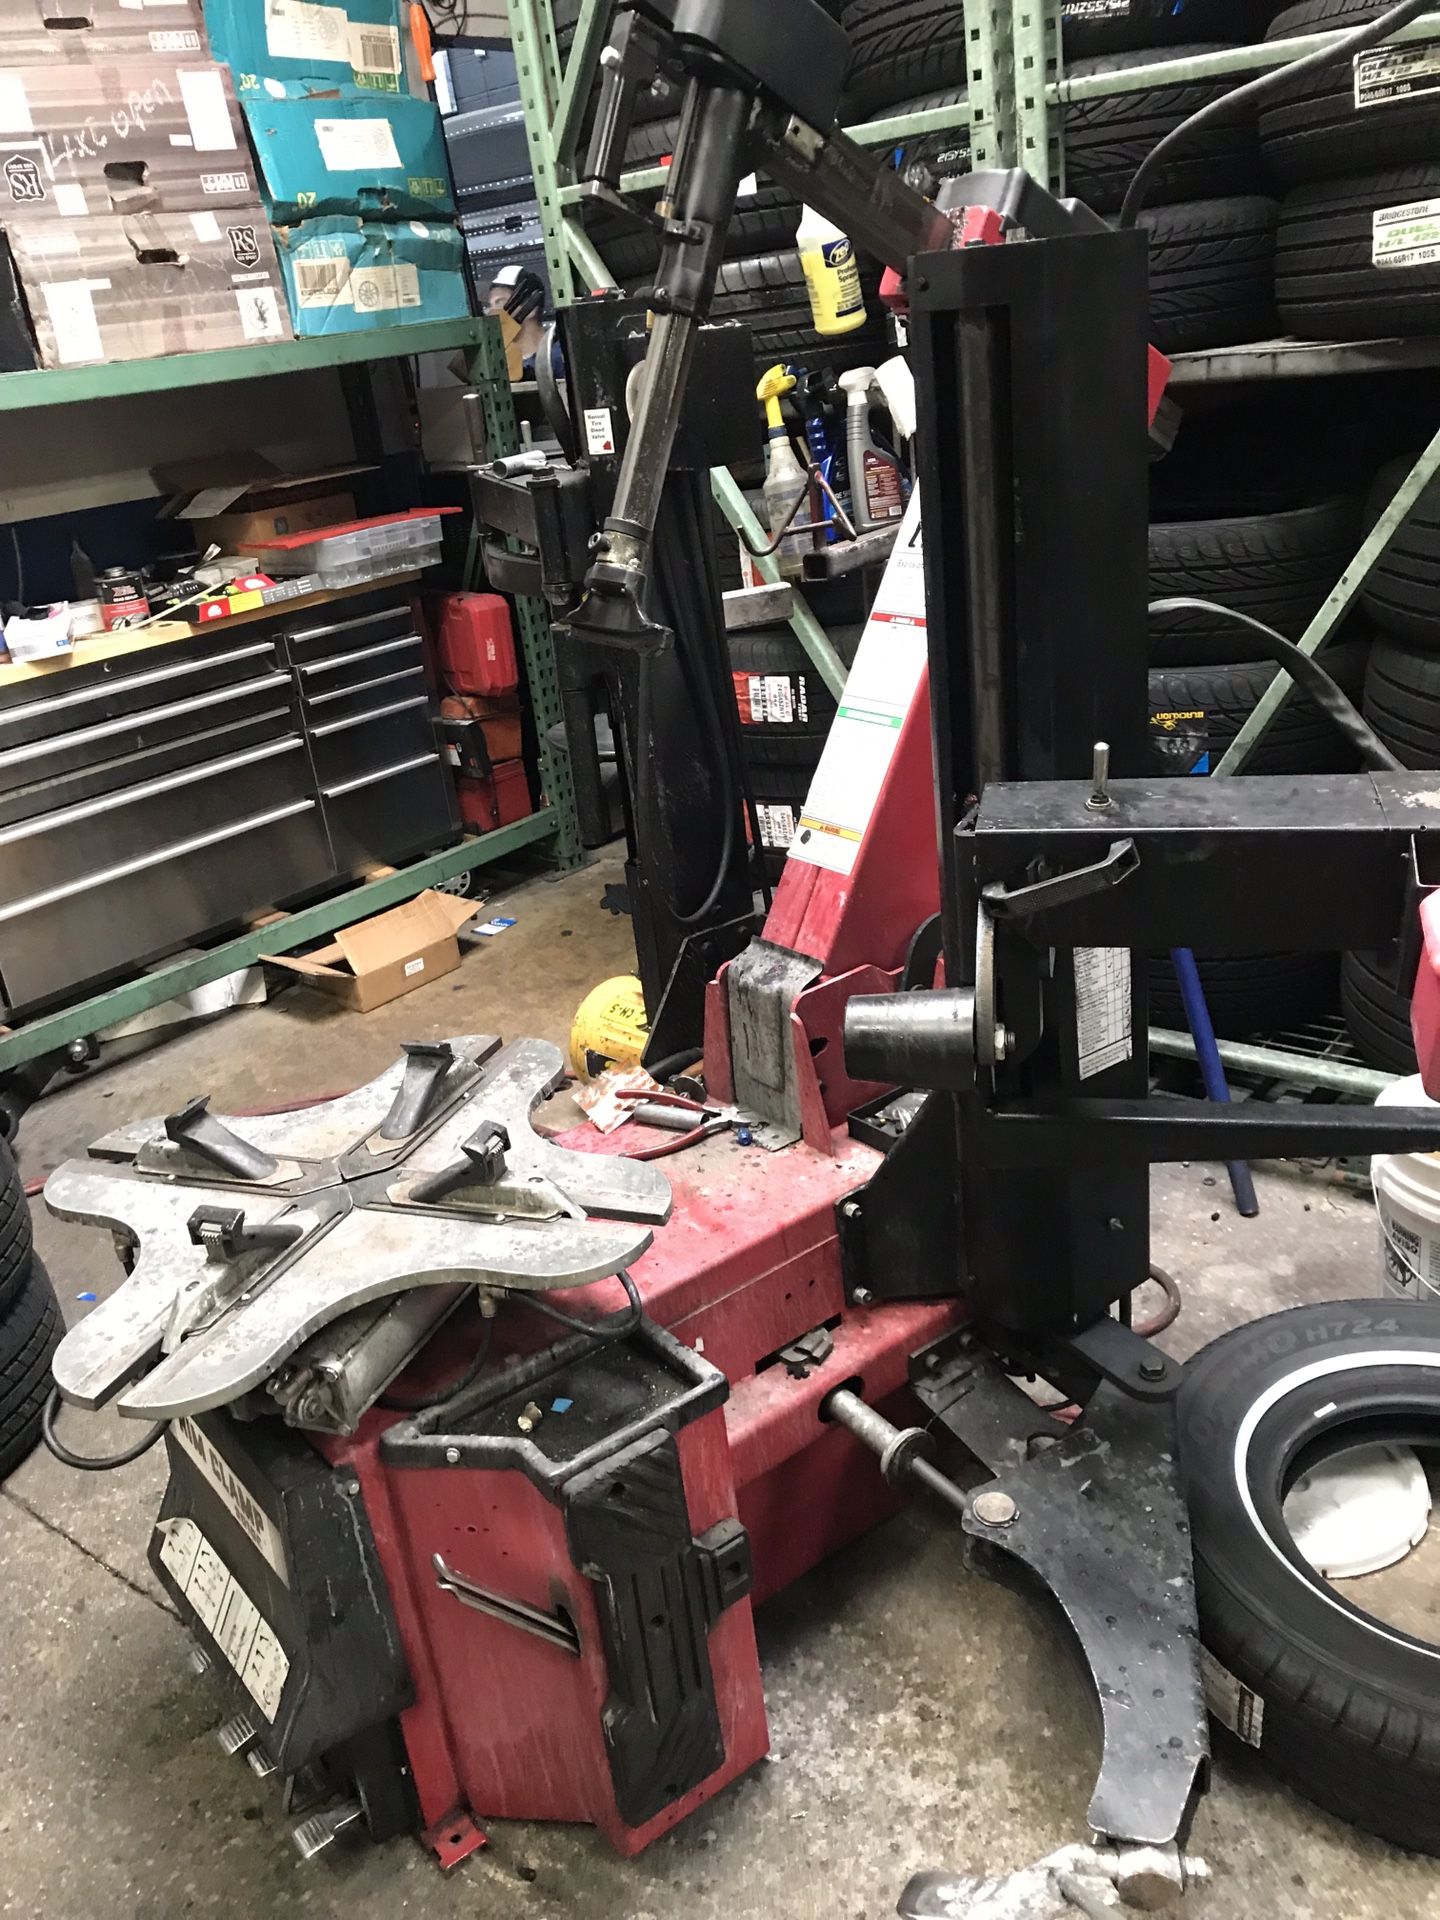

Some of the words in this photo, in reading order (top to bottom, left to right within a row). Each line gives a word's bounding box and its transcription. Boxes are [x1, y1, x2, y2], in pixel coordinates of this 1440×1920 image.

[10, 173, 43, 197] RS
[1378, 205, 1429, 222] BRIDGESTONE
[230, 230, 256, 252] RS
[798, 676, 808, 722] RADAR
[1305, 1317, 1400, 1343] H724
[208, 1447, 265, 1535] CLAMP
